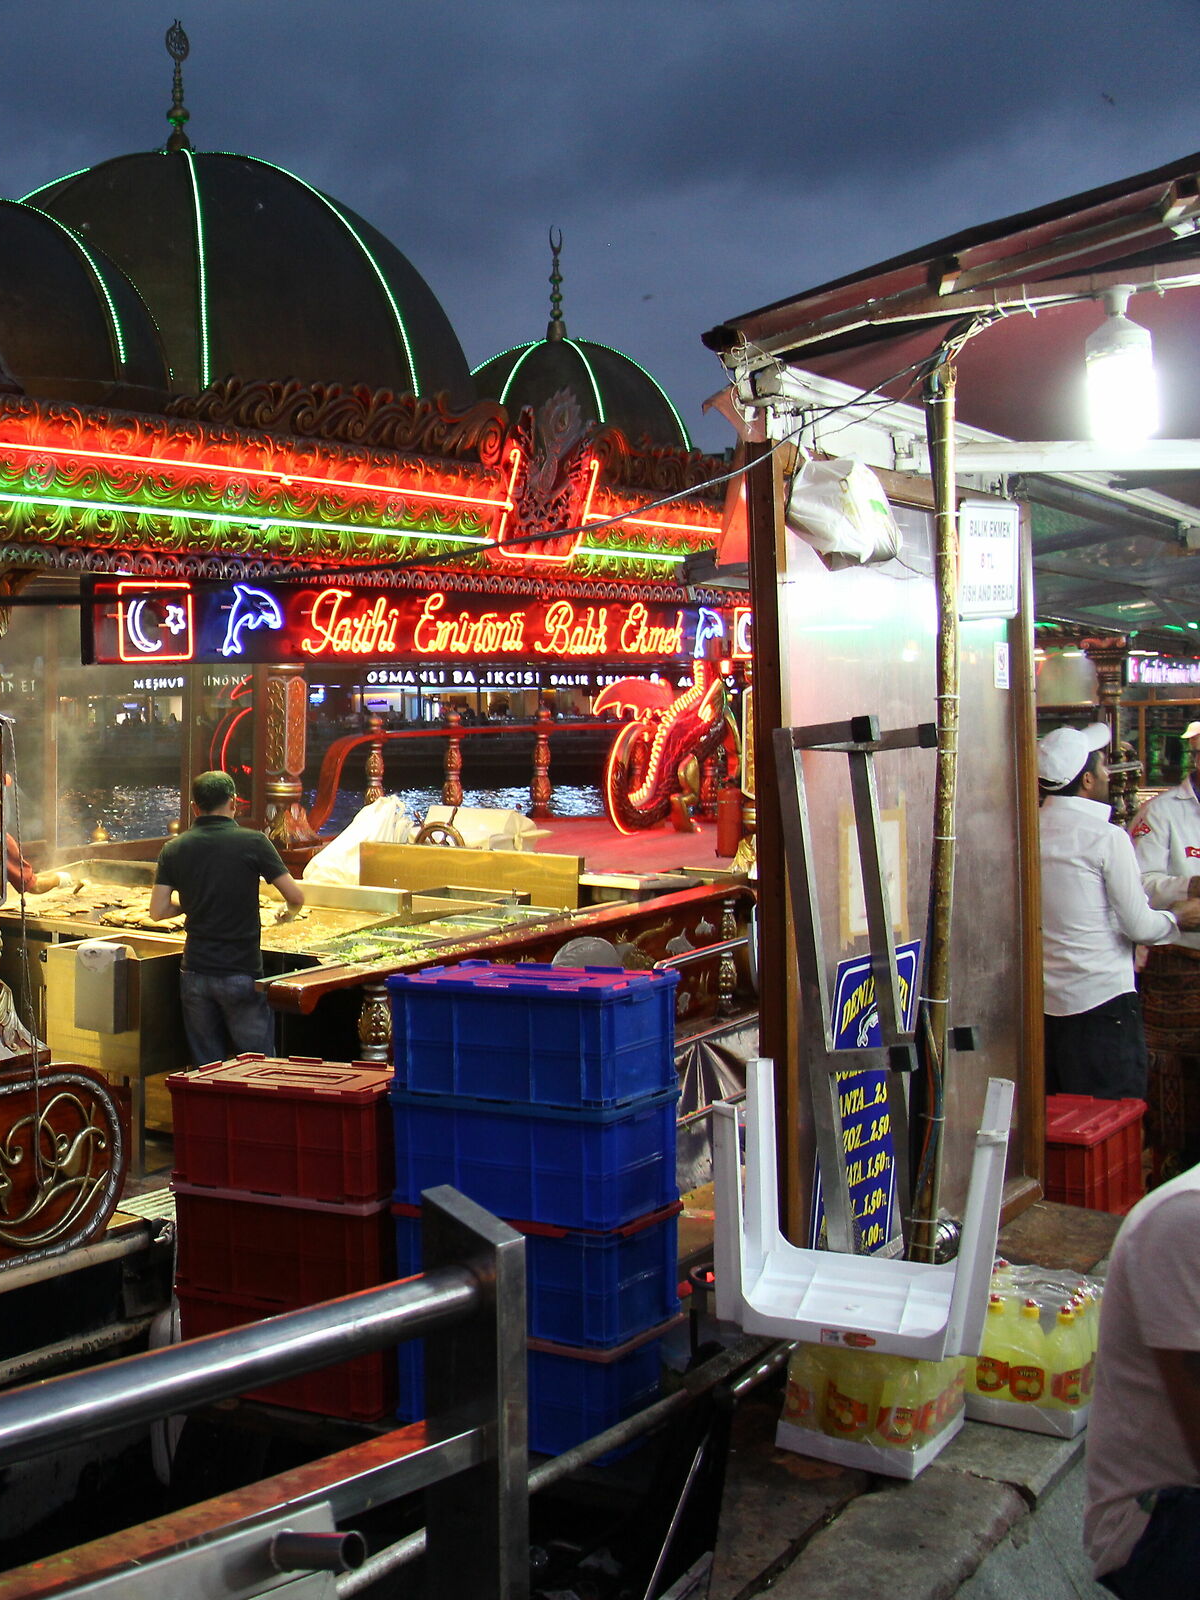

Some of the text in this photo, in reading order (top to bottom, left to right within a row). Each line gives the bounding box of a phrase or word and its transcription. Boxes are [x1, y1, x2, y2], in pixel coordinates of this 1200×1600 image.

[970, 519, 1012, 539] BALIK EKMEK
[987, 552, 996, 570] TL
[962, 584, 977, 603] FISH
[301, 588, 400, 654] Tarihi
[413, 592, 527, 655] Eminönü
[620, 601, 684, 656] Ekmek
